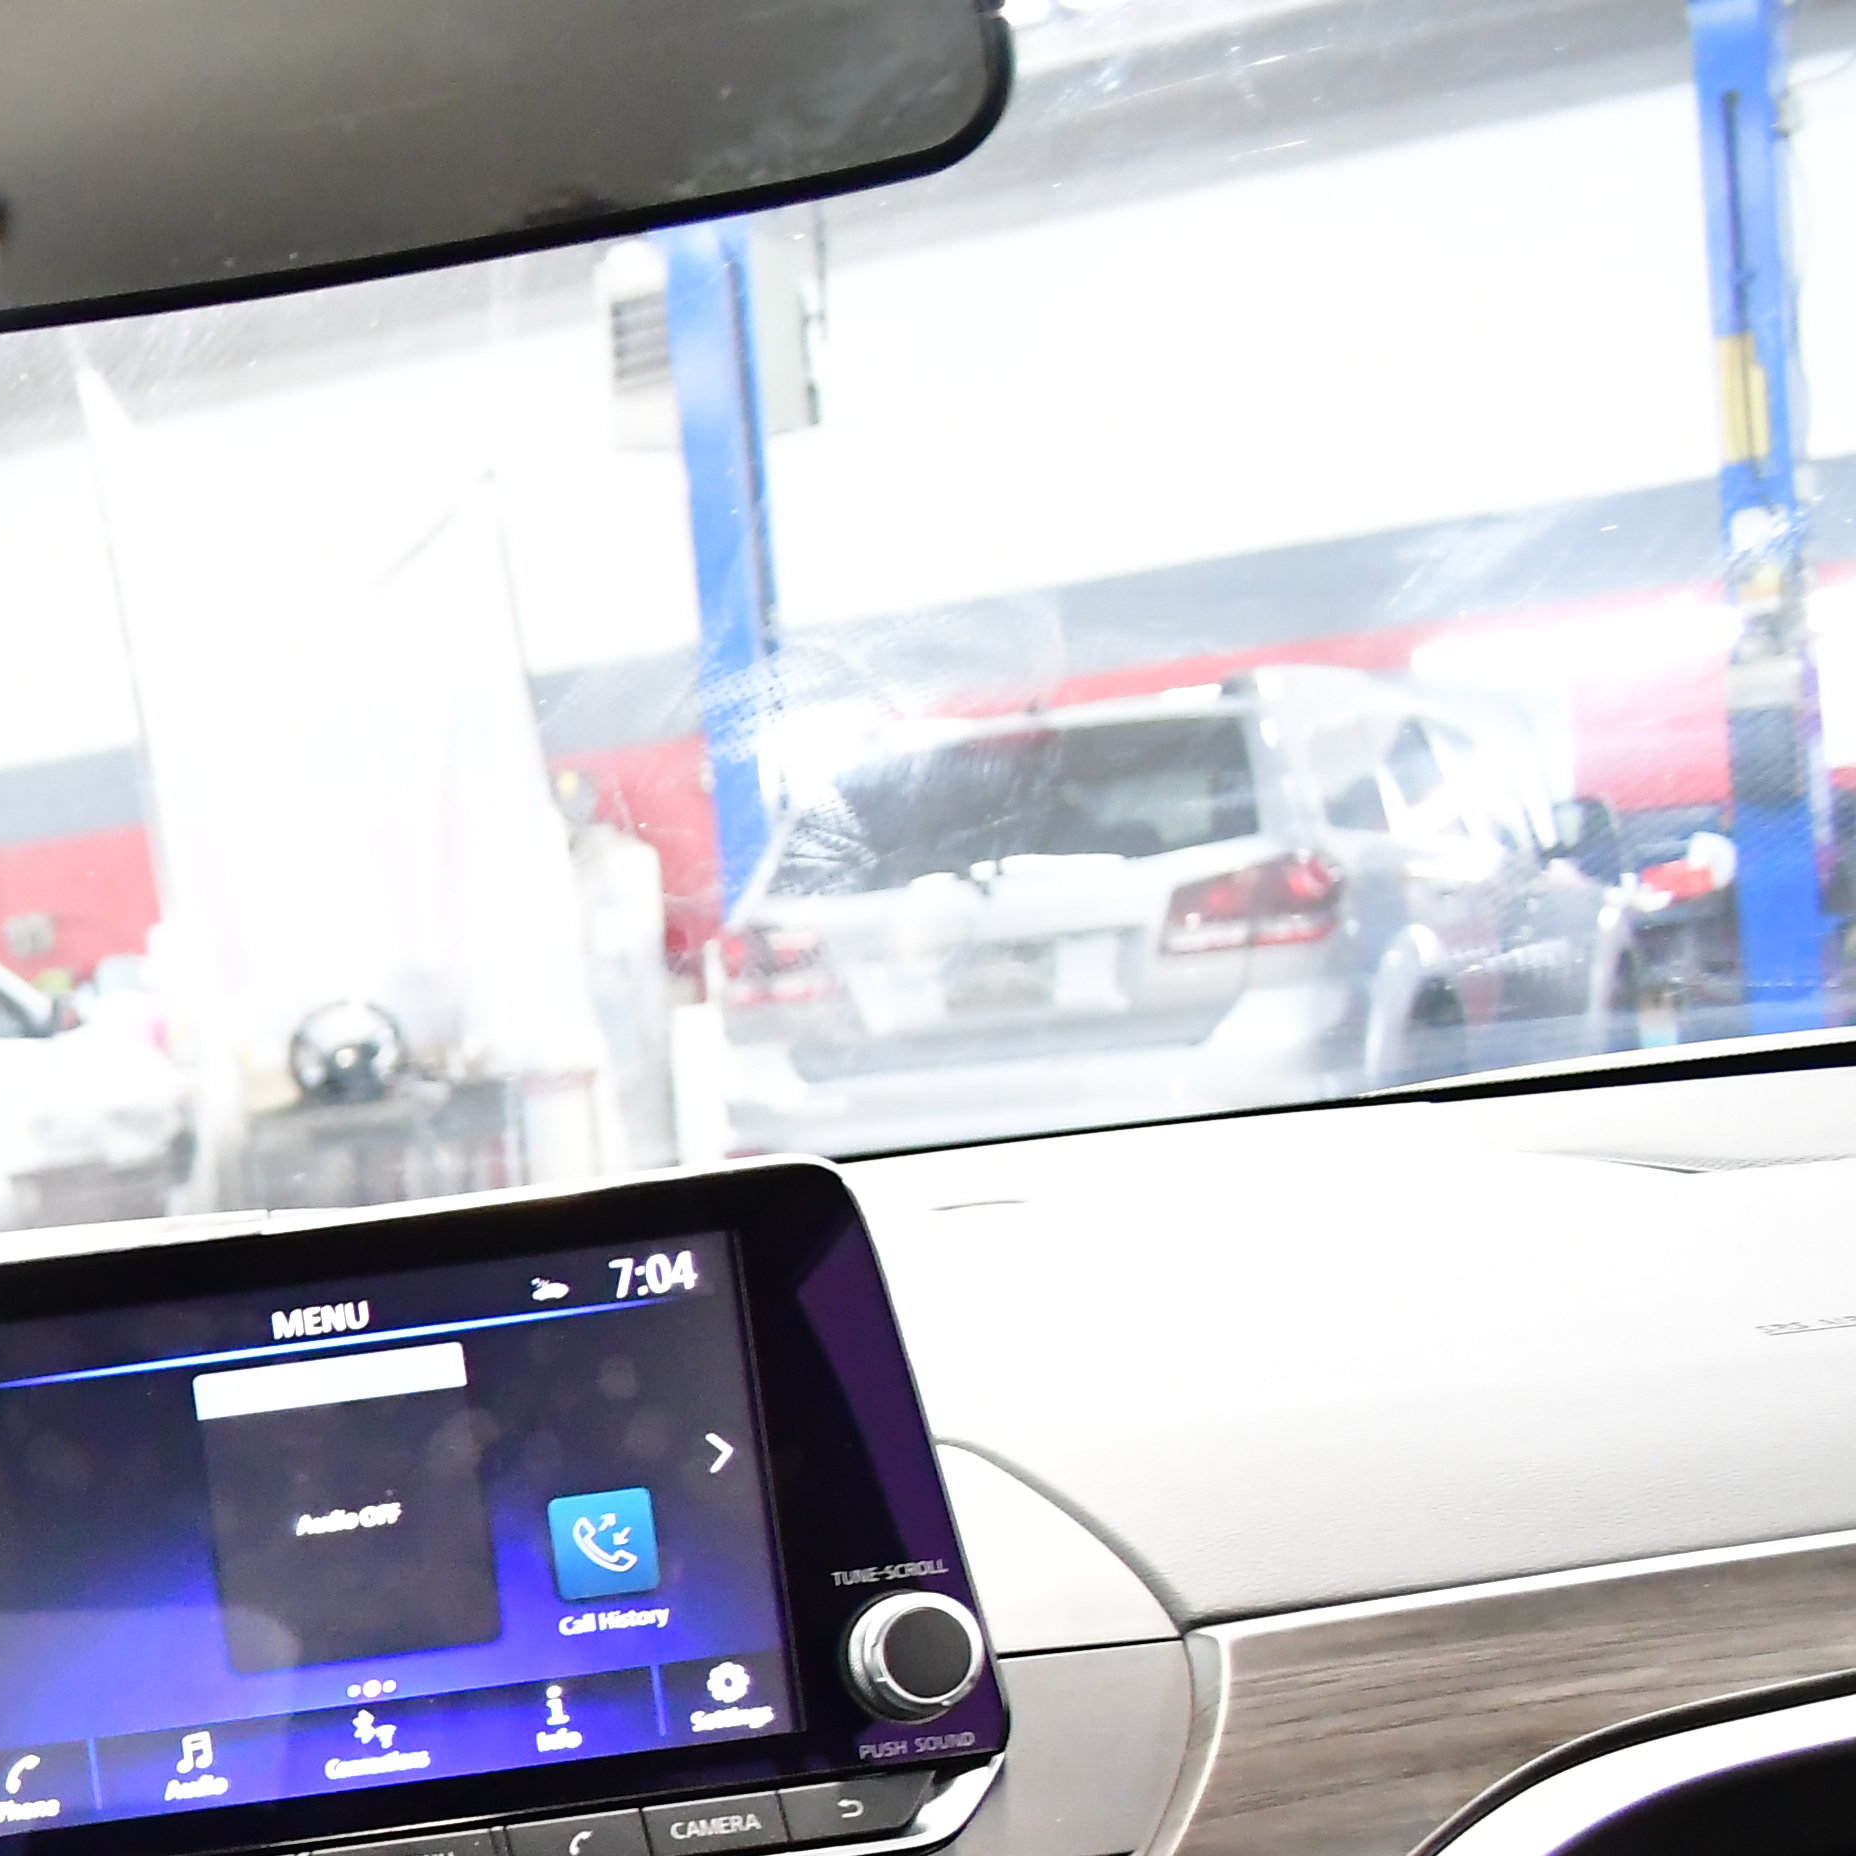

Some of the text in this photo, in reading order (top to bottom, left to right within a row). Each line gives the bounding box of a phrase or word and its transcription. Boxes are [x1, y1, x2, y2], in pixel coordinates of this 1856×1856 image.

[608, 1250, 698, 1299] 7:04
[271, 1300, 369, 1340] MENU
[295, 1507, 359, 1536] Audio
[558, 1606, 670, 1637] Call History
[691, 1704, 775, 1733] Settings
[536, 1728, 583, 1752] Info
[858, 1731, 975, 1760] PUSH SOUND
[165, 1774, 229, 1802] Audio
[670, 1812, 763, 1841] CAMERA
